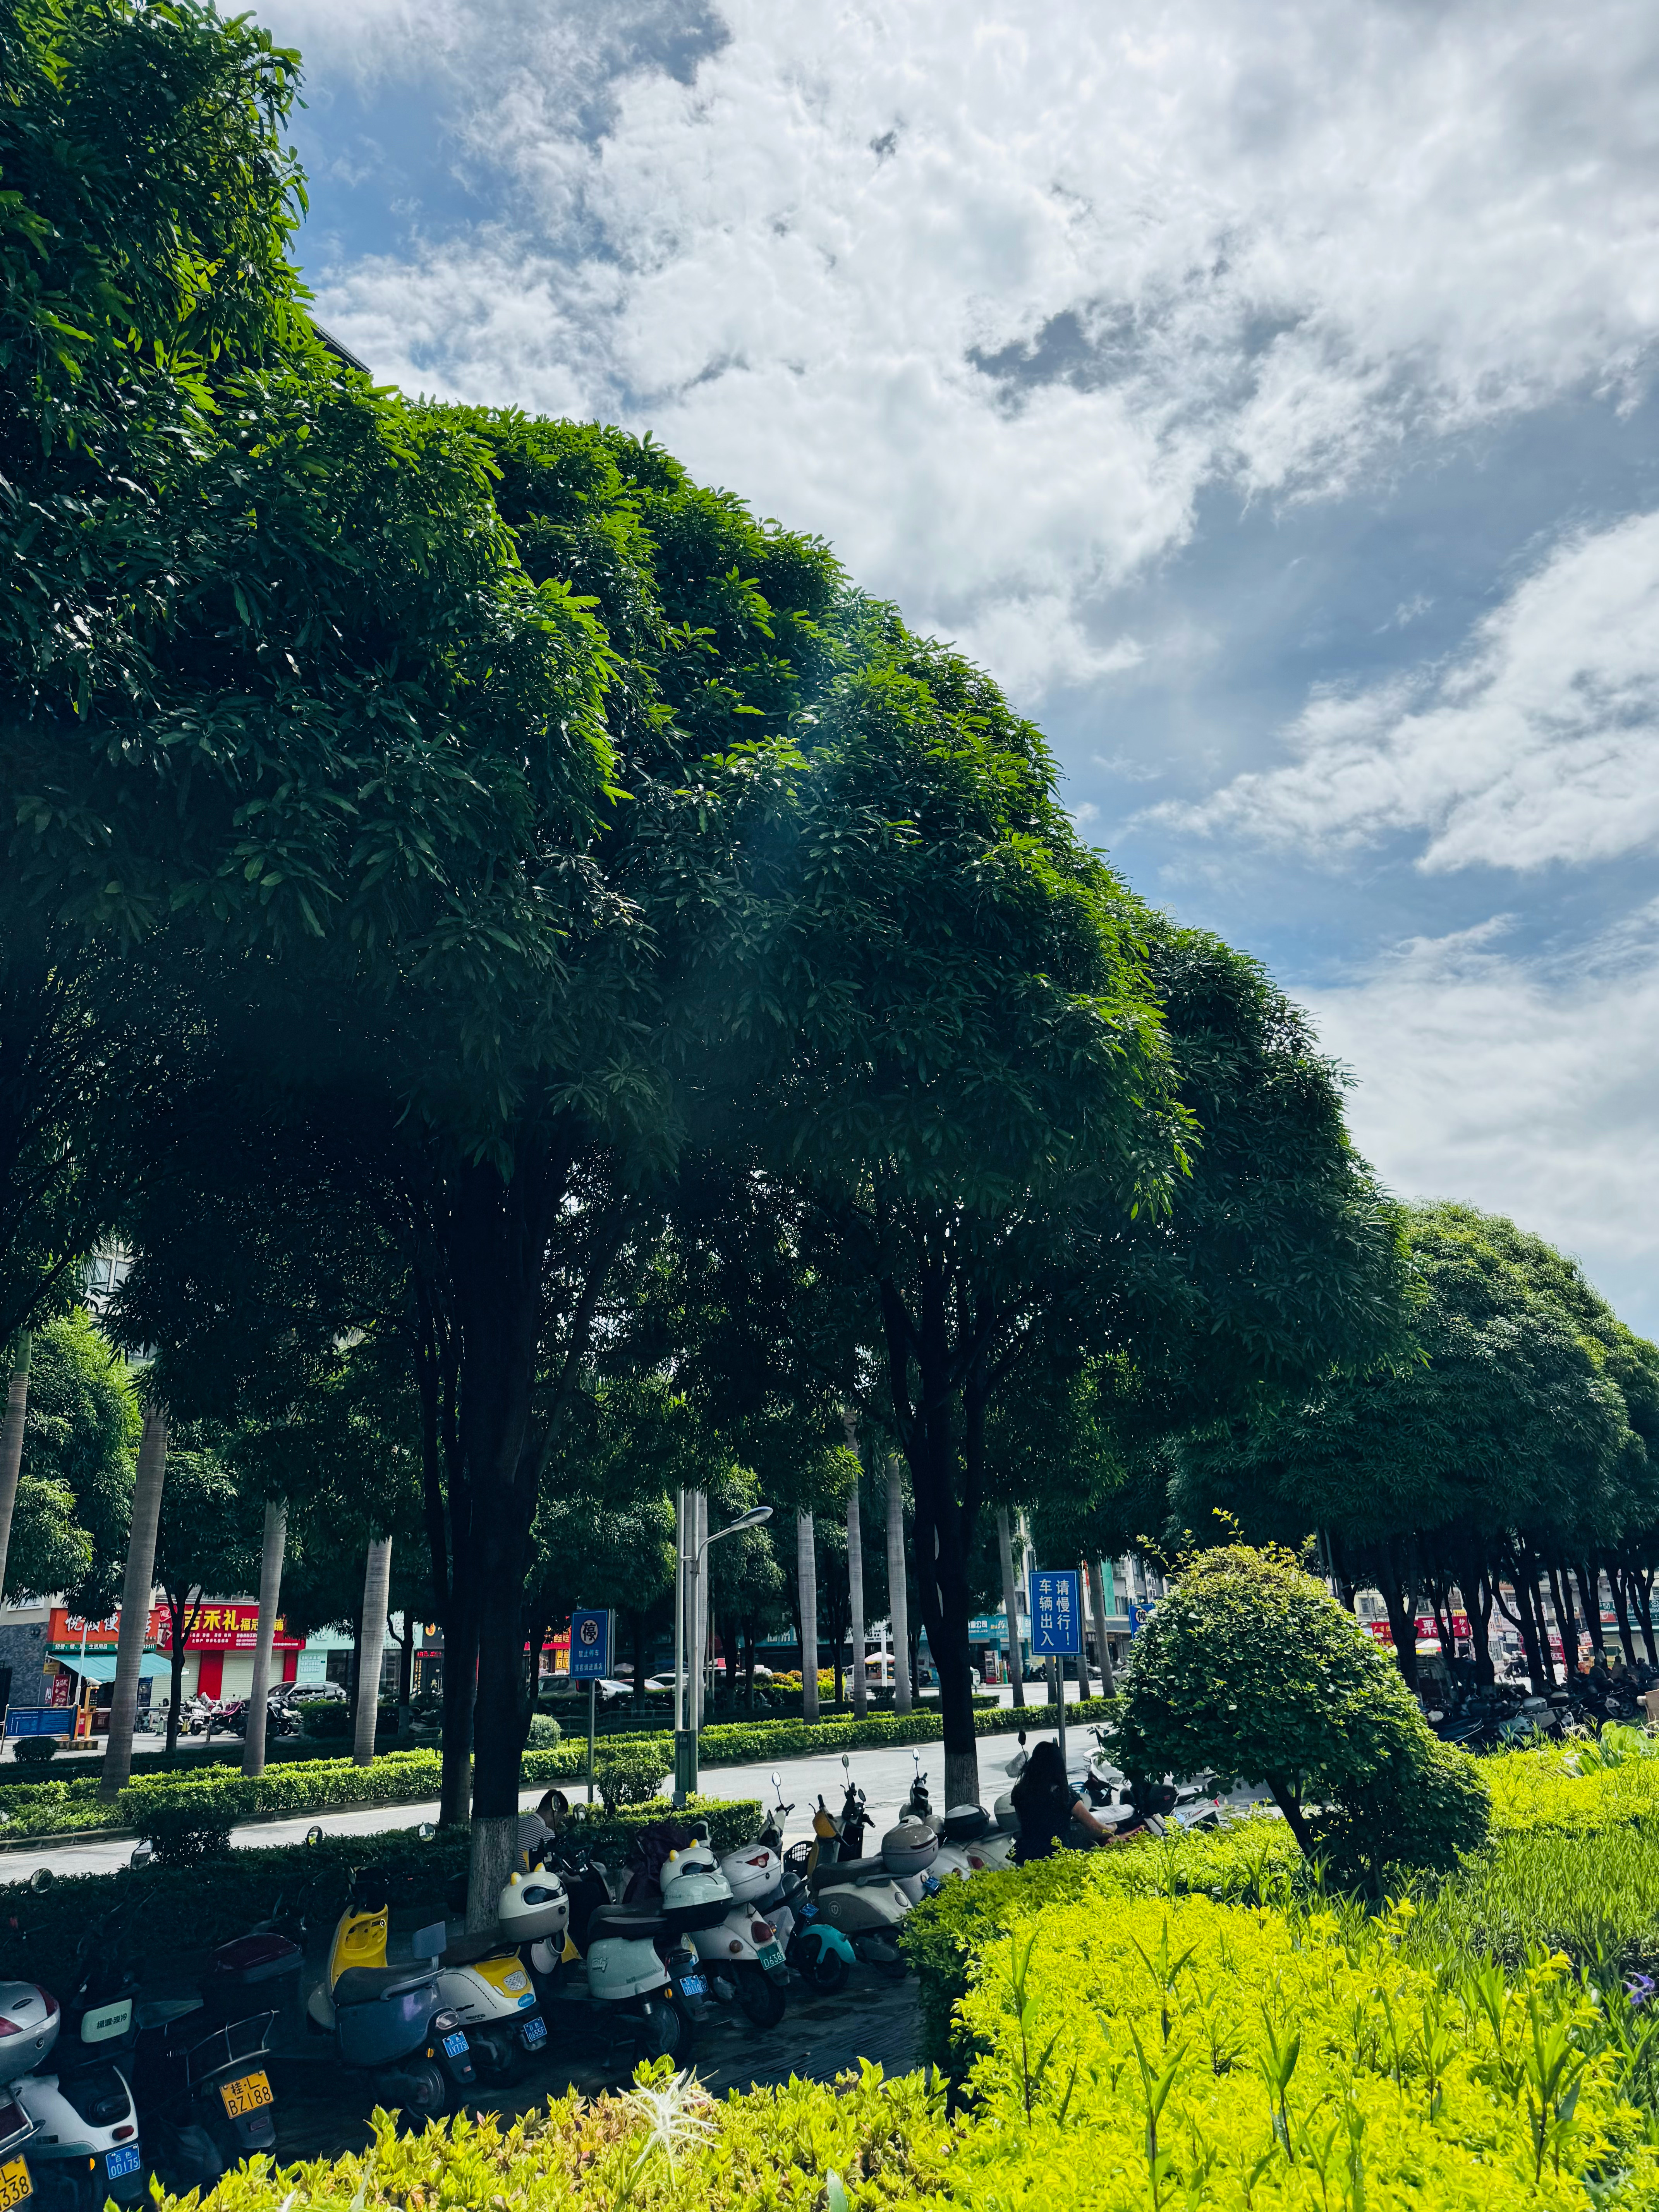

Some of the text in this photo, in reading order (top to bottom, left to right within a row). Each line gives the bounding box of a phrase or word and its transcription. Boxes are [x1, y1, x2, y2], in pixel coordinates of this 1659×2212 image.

[1039, 1579, 1054, 1646] 车辆出入
[1056, 1579, 1071, 1645] 请慢行！
[583, 1622, 596, 1641] 停
[529, 2027, 544, 2040] 0655F
[230, 2077, 260, 2096] 桂·L
[228, 2087, 271, 2115] BZ188
[0, 2176, 29, 2211] 338
